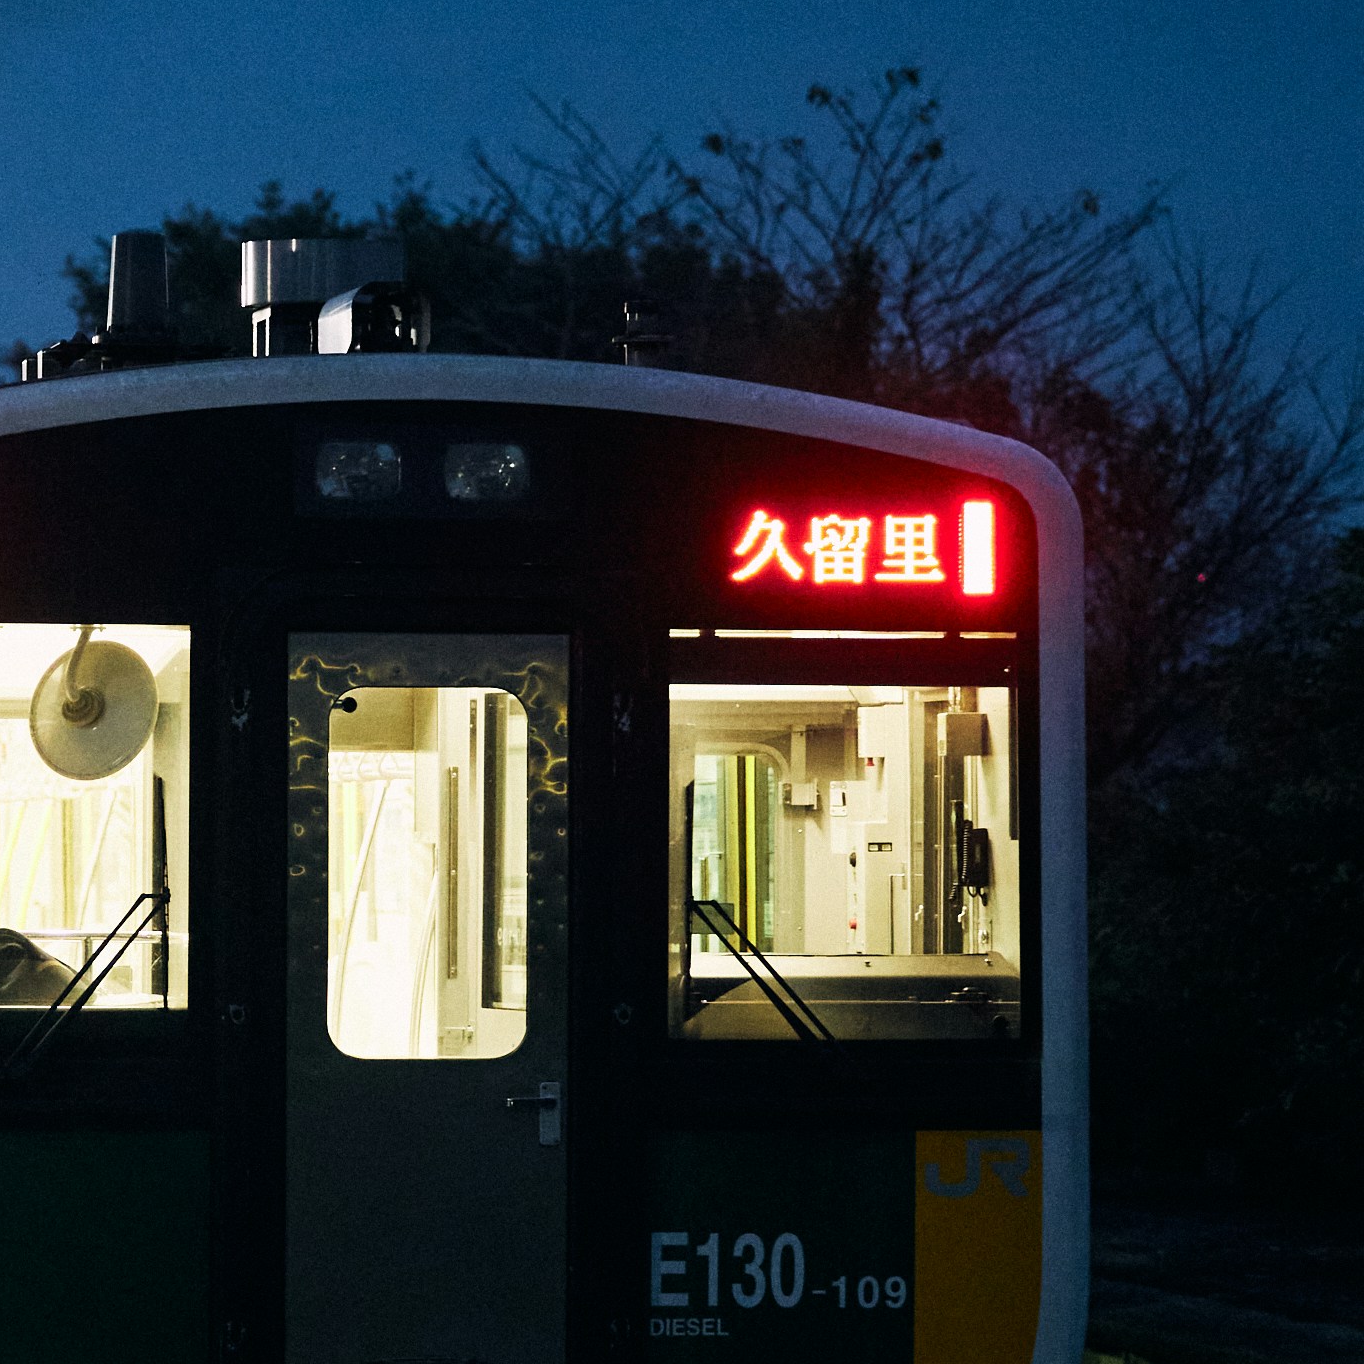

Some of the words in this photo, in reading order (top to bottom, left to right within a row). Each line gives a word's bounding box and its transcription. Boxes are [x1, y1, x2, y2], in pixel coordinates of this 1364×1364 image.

[732, 509, 946, 584] 久留里
[924, 1138, 1030, 1197] JR
[650, 1318, 730, 1336] DIESEL
